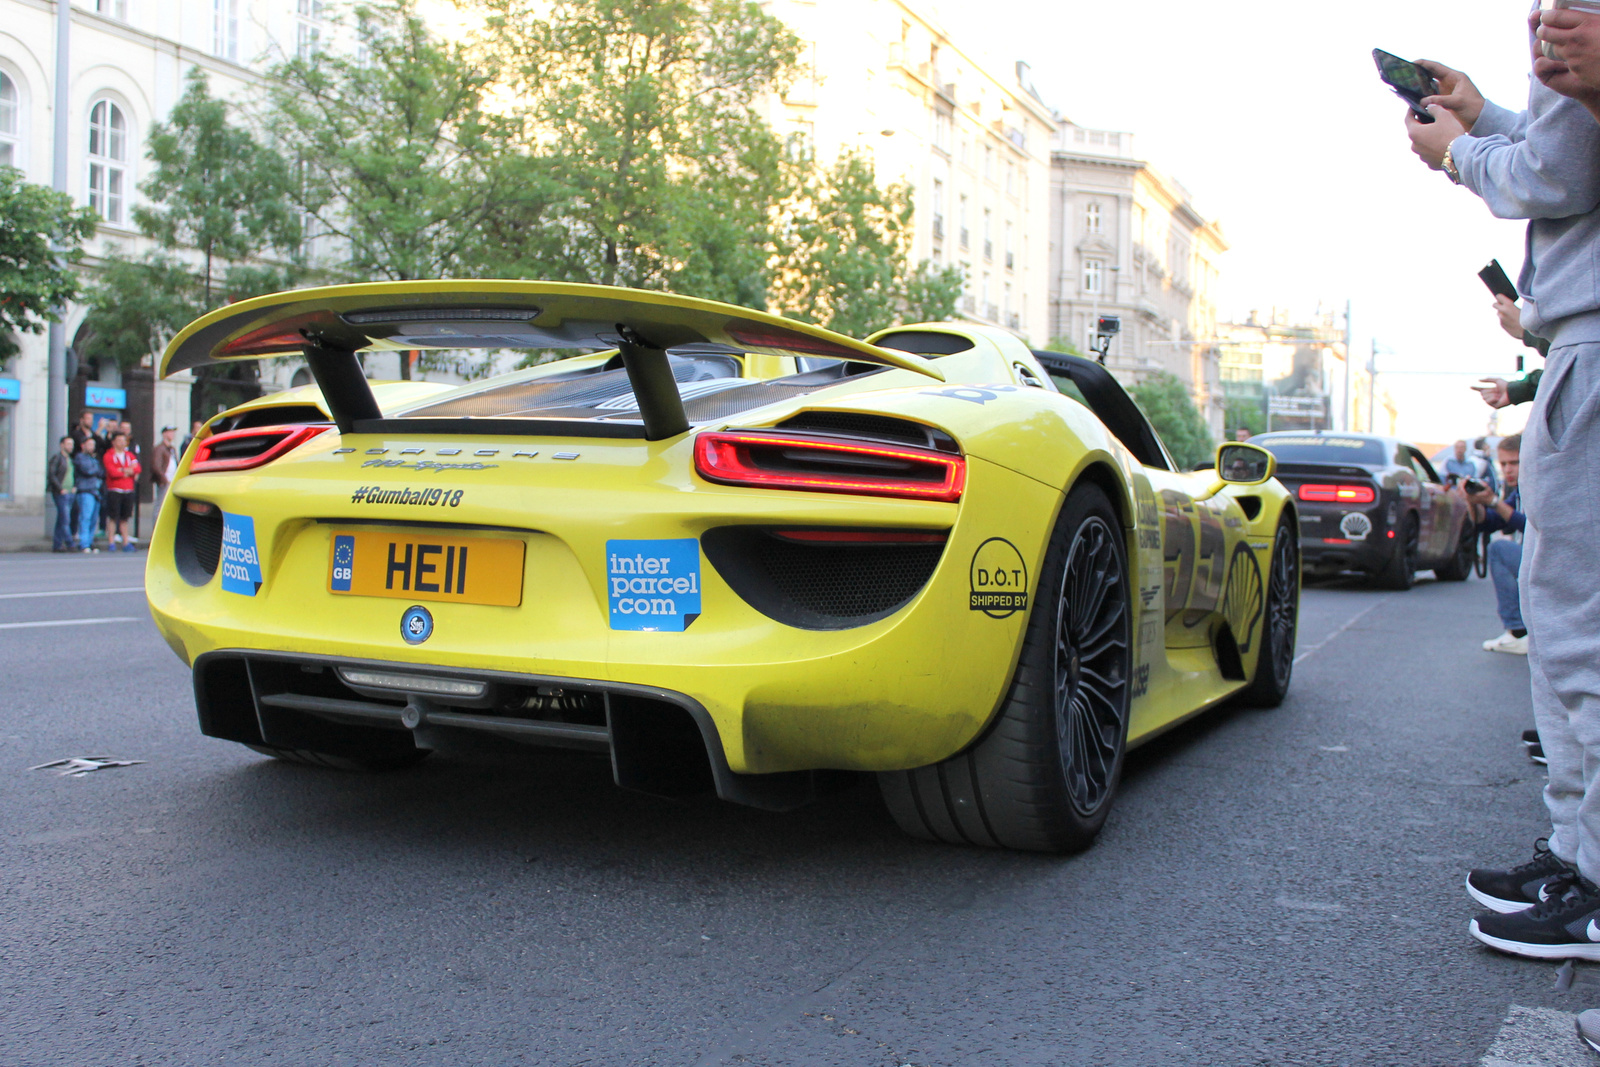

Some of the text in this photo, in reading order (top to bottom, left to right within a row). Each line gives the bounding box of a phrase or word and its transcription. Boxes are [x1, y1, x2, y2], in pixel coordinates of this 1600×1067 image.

[332, 447, 581, 460] PORSCHE
[351, 486, 464, 507] #Gumball918
[223, 525, 241, 545] nter
[222, 543, 258, 565] parcel
[610, 553, 671, 574] inter
[223, 562, 250, 581] .com
[333, 567, 352, 580] GB
[978, 567, 1021, 587] D.O.T
[611, 572, 698, 597] parcel
[612, 598, 677, 615] .com
[971, 595, 1027, 607] SHIPPED BY
